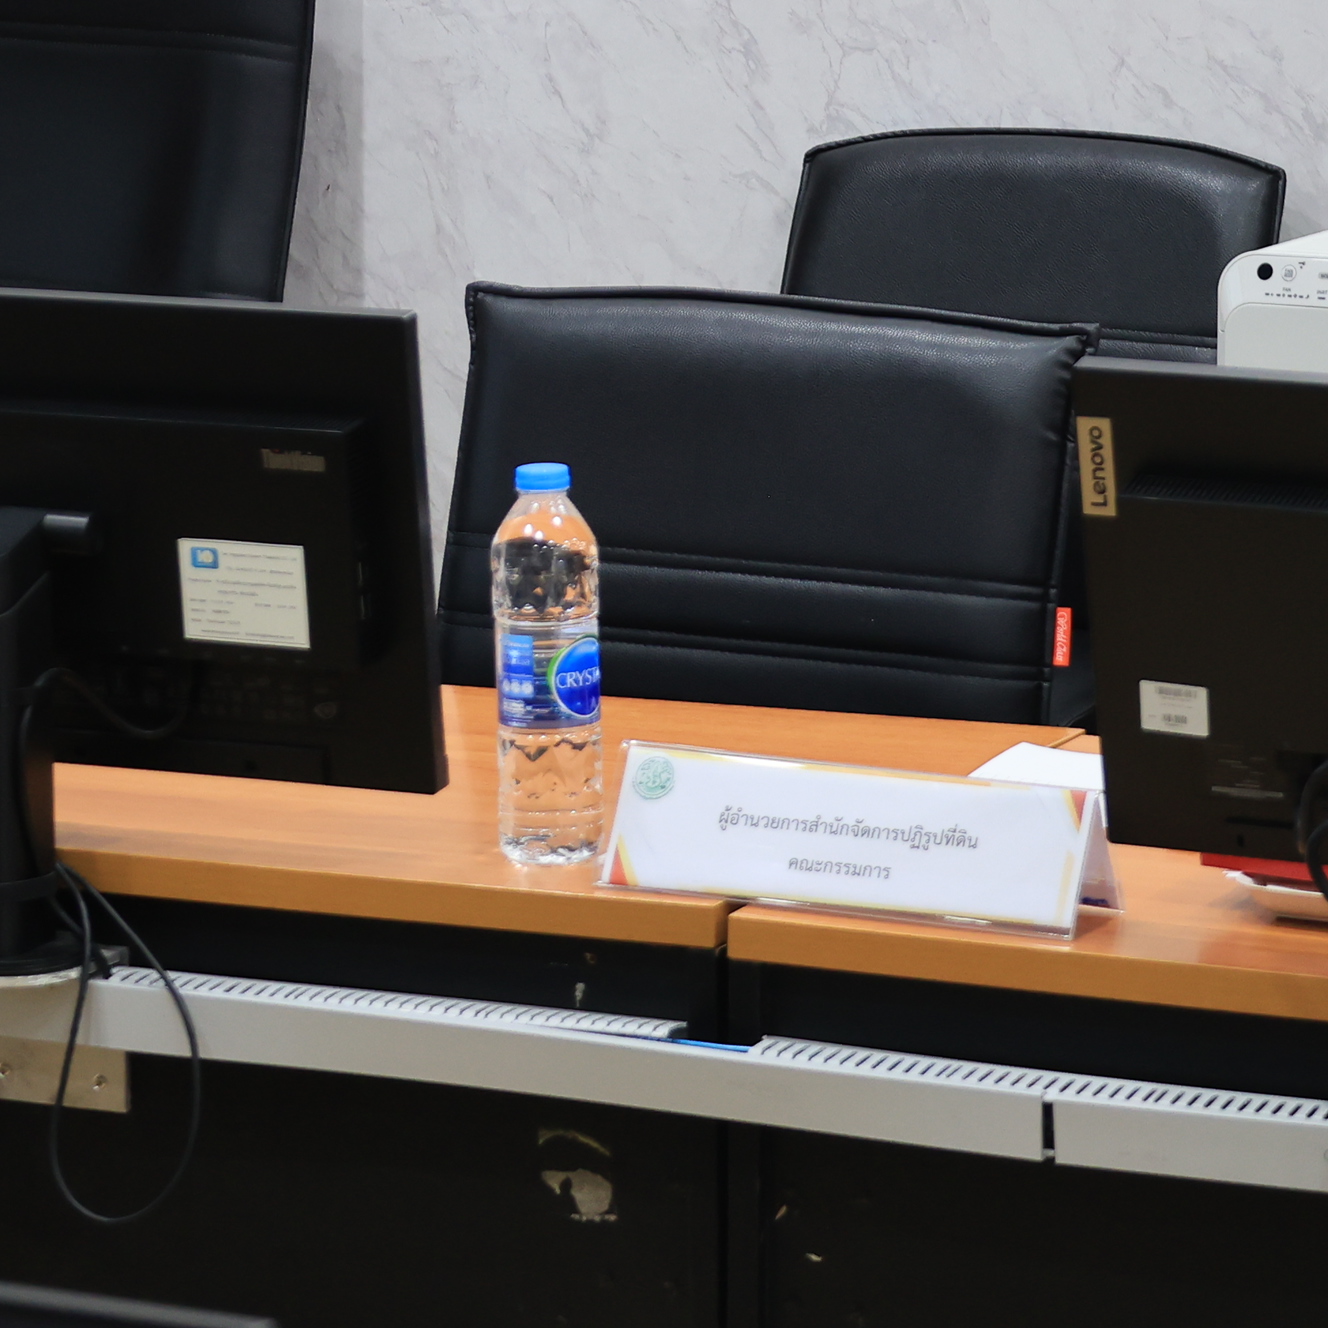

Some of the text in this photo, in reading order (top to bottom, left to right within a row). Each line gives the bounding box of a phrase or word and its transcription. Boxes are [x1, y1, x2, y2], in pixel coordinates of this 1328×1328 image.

[1089, 425, 1108, 507] Lenovo
[718, 805, 979, 851] ผู้อำนวยการสำนักจัดการปฏิรูปที่ดิน
[787, 856, 892, 880] คณะกรรมการ
